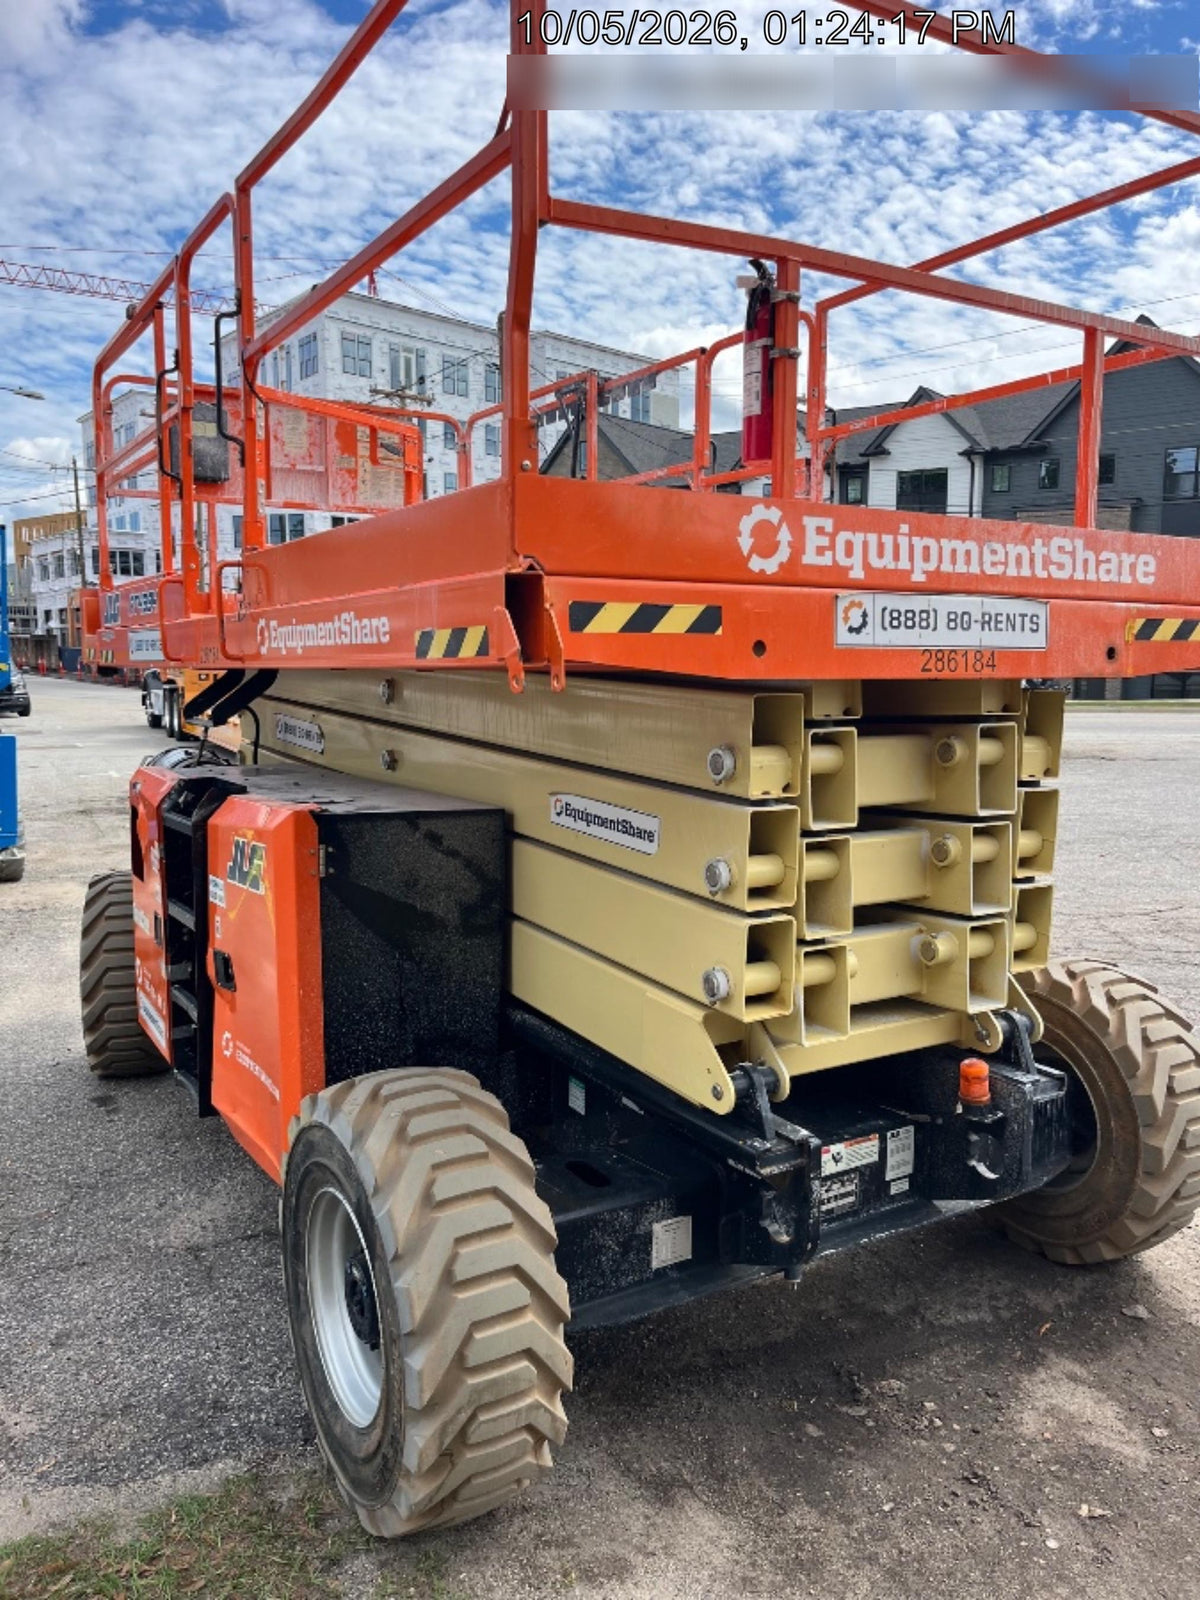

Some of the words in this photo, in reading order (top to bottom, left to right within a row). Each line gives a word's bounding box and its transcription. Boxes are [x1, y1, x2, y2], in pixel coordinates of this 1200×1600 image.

[801, 515, 1157, 584] EquipmentShare
[269, 611, 391, 655] EquipmentShare
[881, 606, 938, 632] (888)
[946, 610, 1041, 633] 80-RENTS
[921, 649, 997, 673] 286184
[564, 800, 655, 843] EquipmentShare
